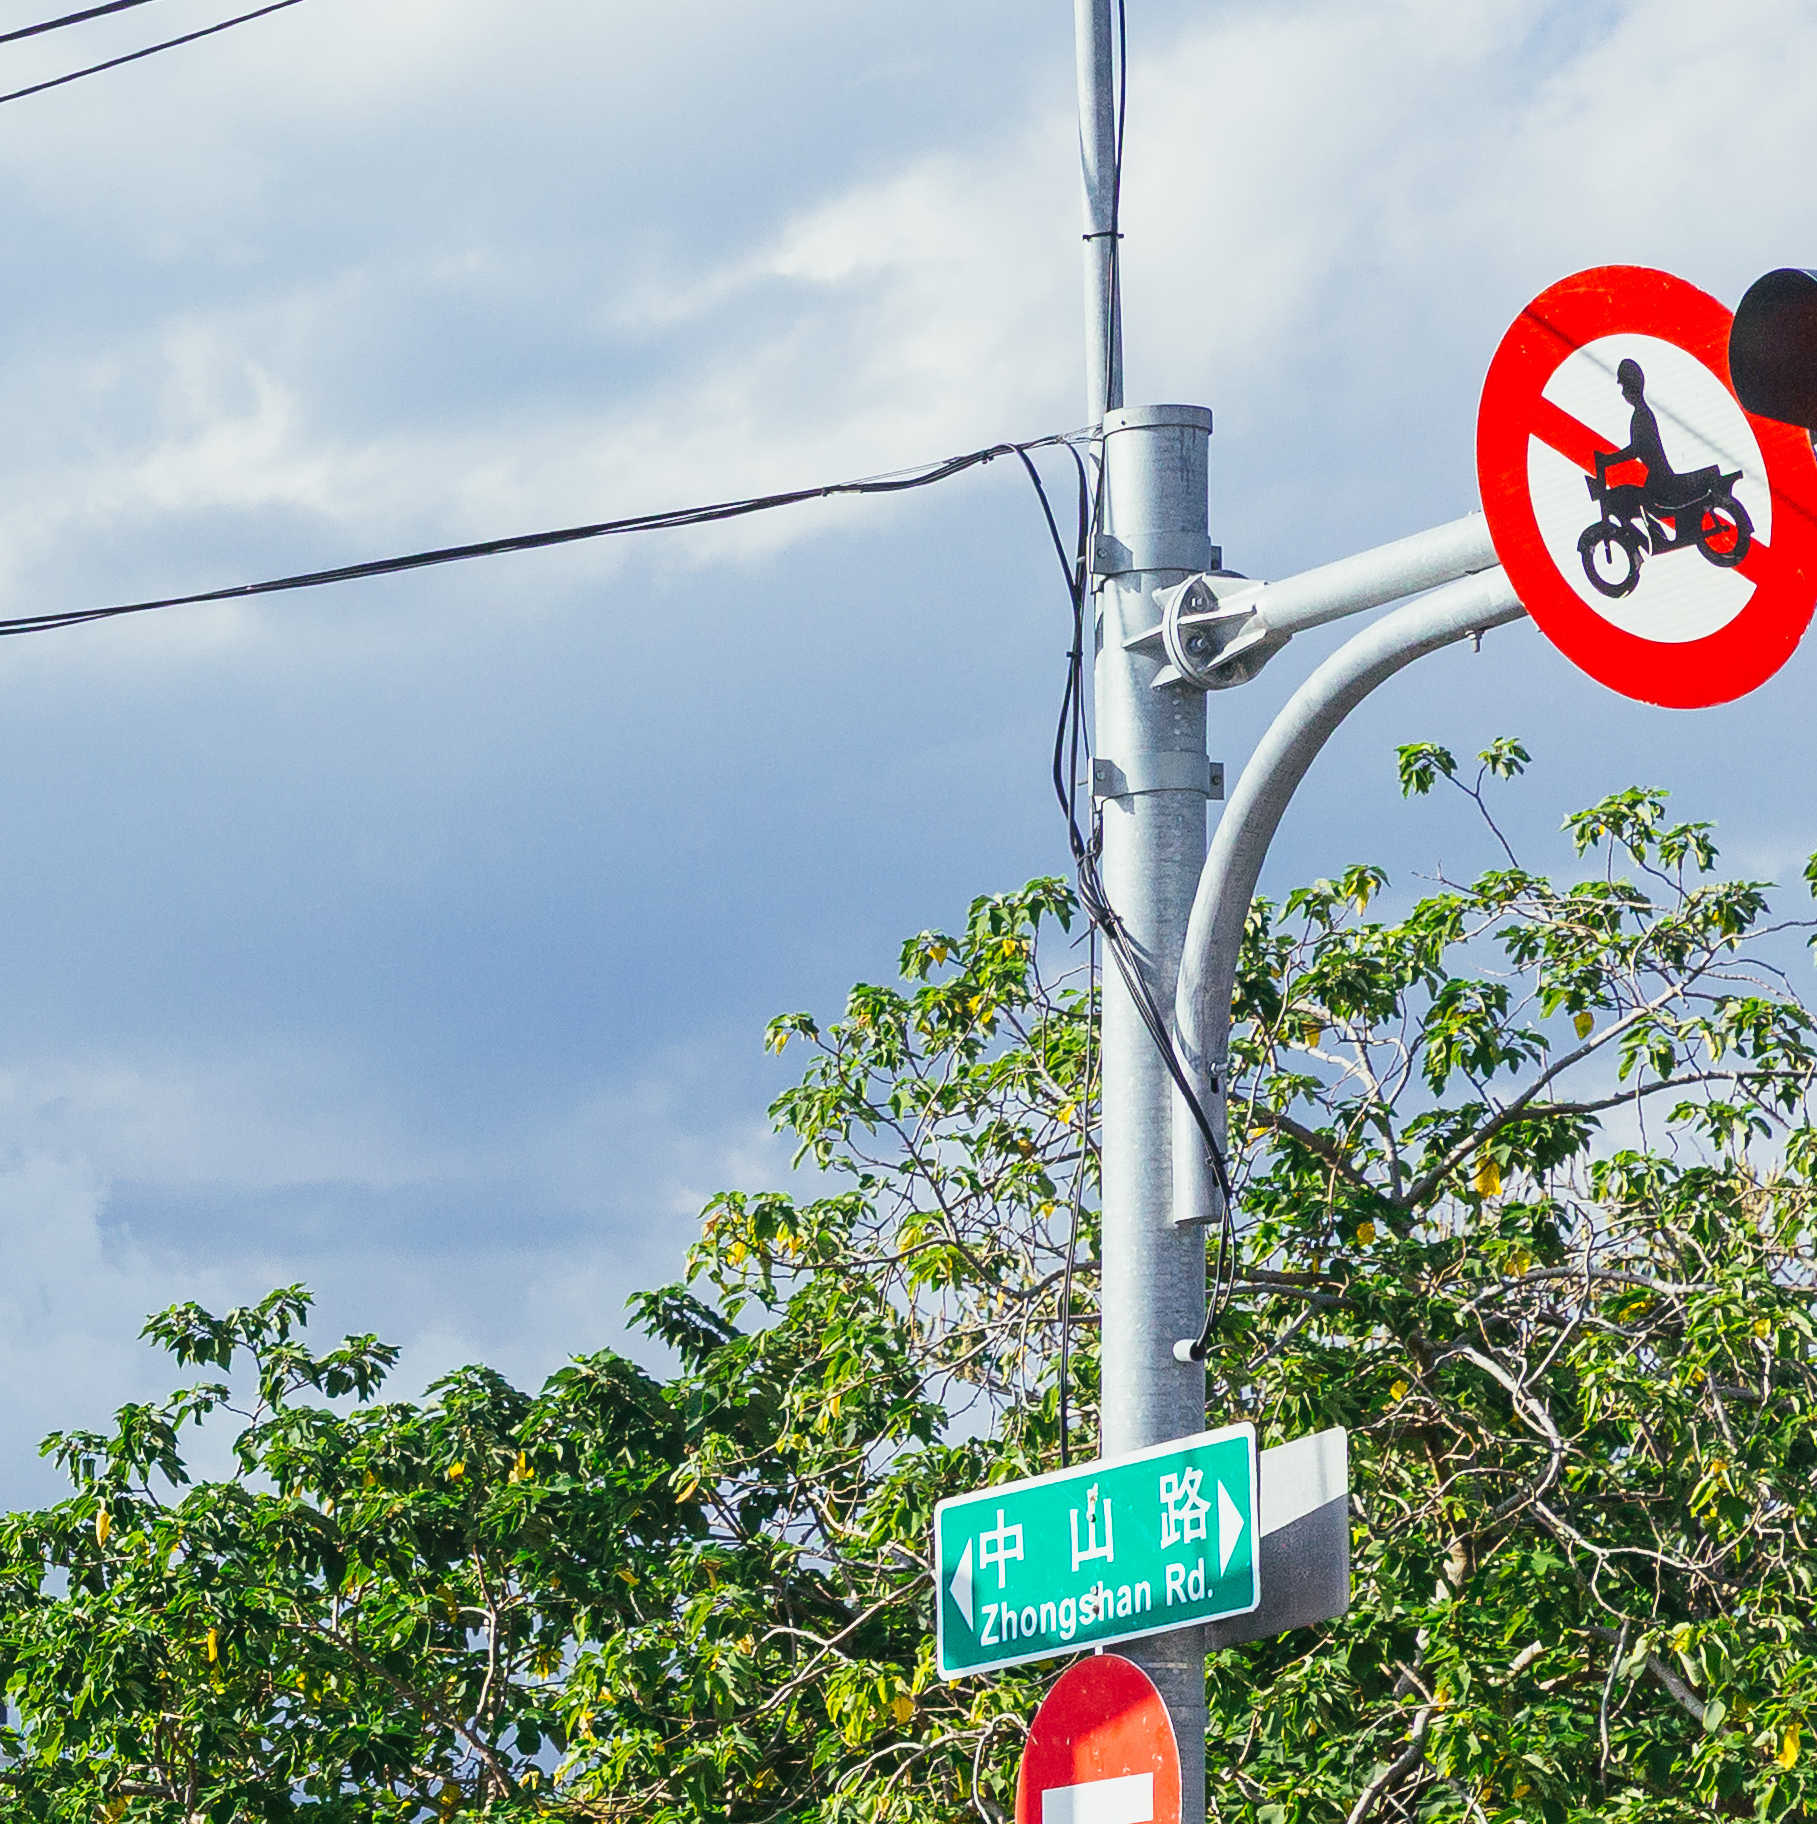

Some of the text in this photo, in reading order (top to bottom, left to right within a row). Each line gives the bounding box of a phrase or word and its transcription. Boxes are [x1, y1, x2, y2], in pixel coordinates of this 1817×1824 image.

[979, 1466, 1213, 1590] 中山路
[980, 1557, 1215, 1647] Zhongshan Rd.
